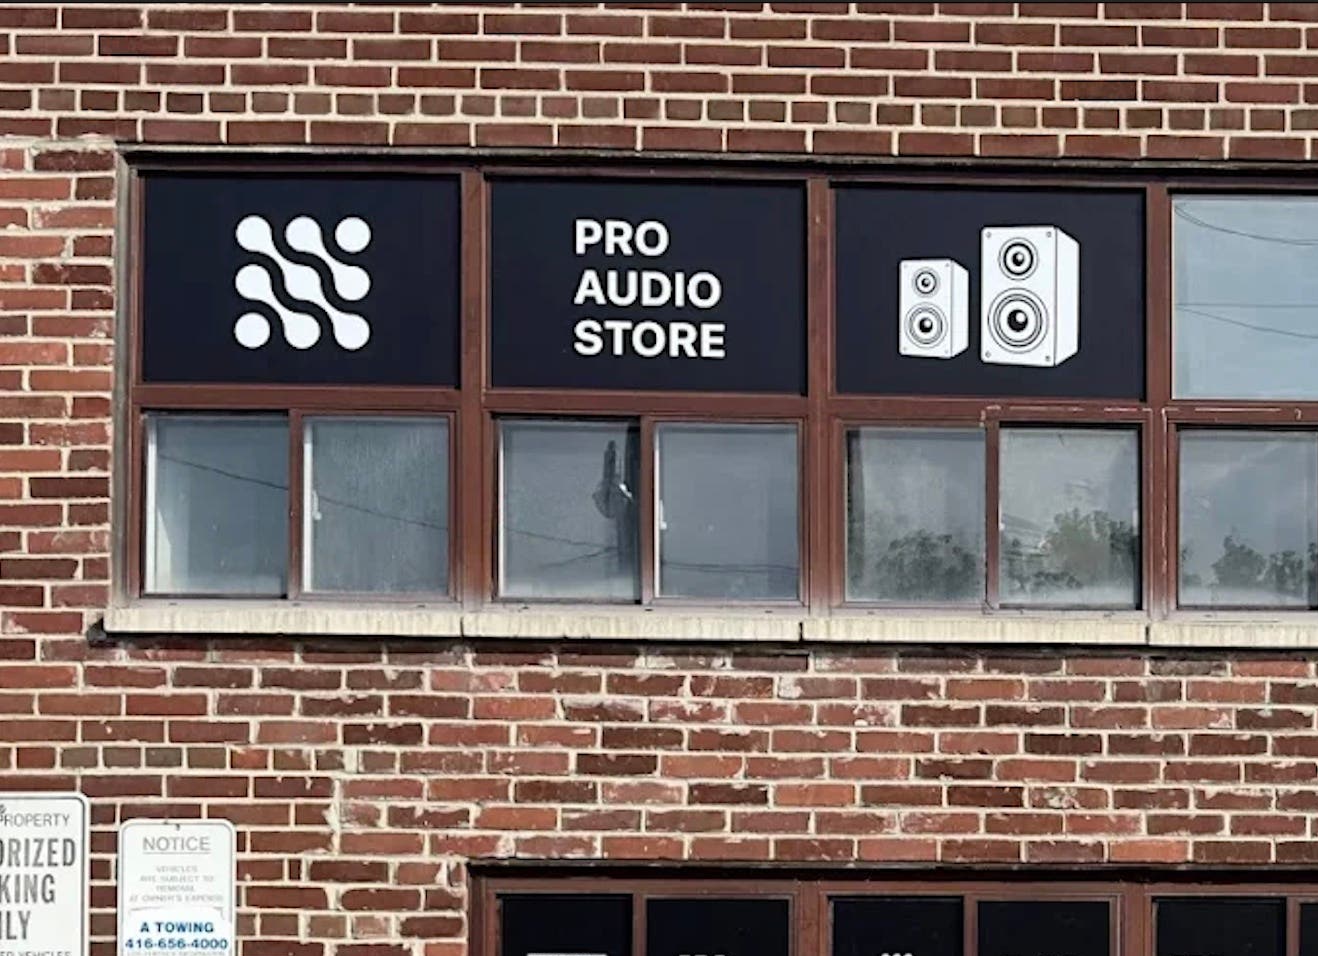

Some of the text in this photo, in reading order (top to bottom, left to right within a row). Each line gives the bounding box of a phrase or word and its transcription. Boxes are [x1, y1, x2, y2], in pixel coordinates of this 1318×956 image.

[576, 220, 668, 256] PRO
[574, 270, 721, 308] AUDIO
[575, 320, 725, 357] STORE
[143, 837, 210, 851] NOTICE
[0, 911, 30, 940] LY
[141, 922, 213, 933] A TOWING
[126, 938, 228, 949] 416-656-4000
